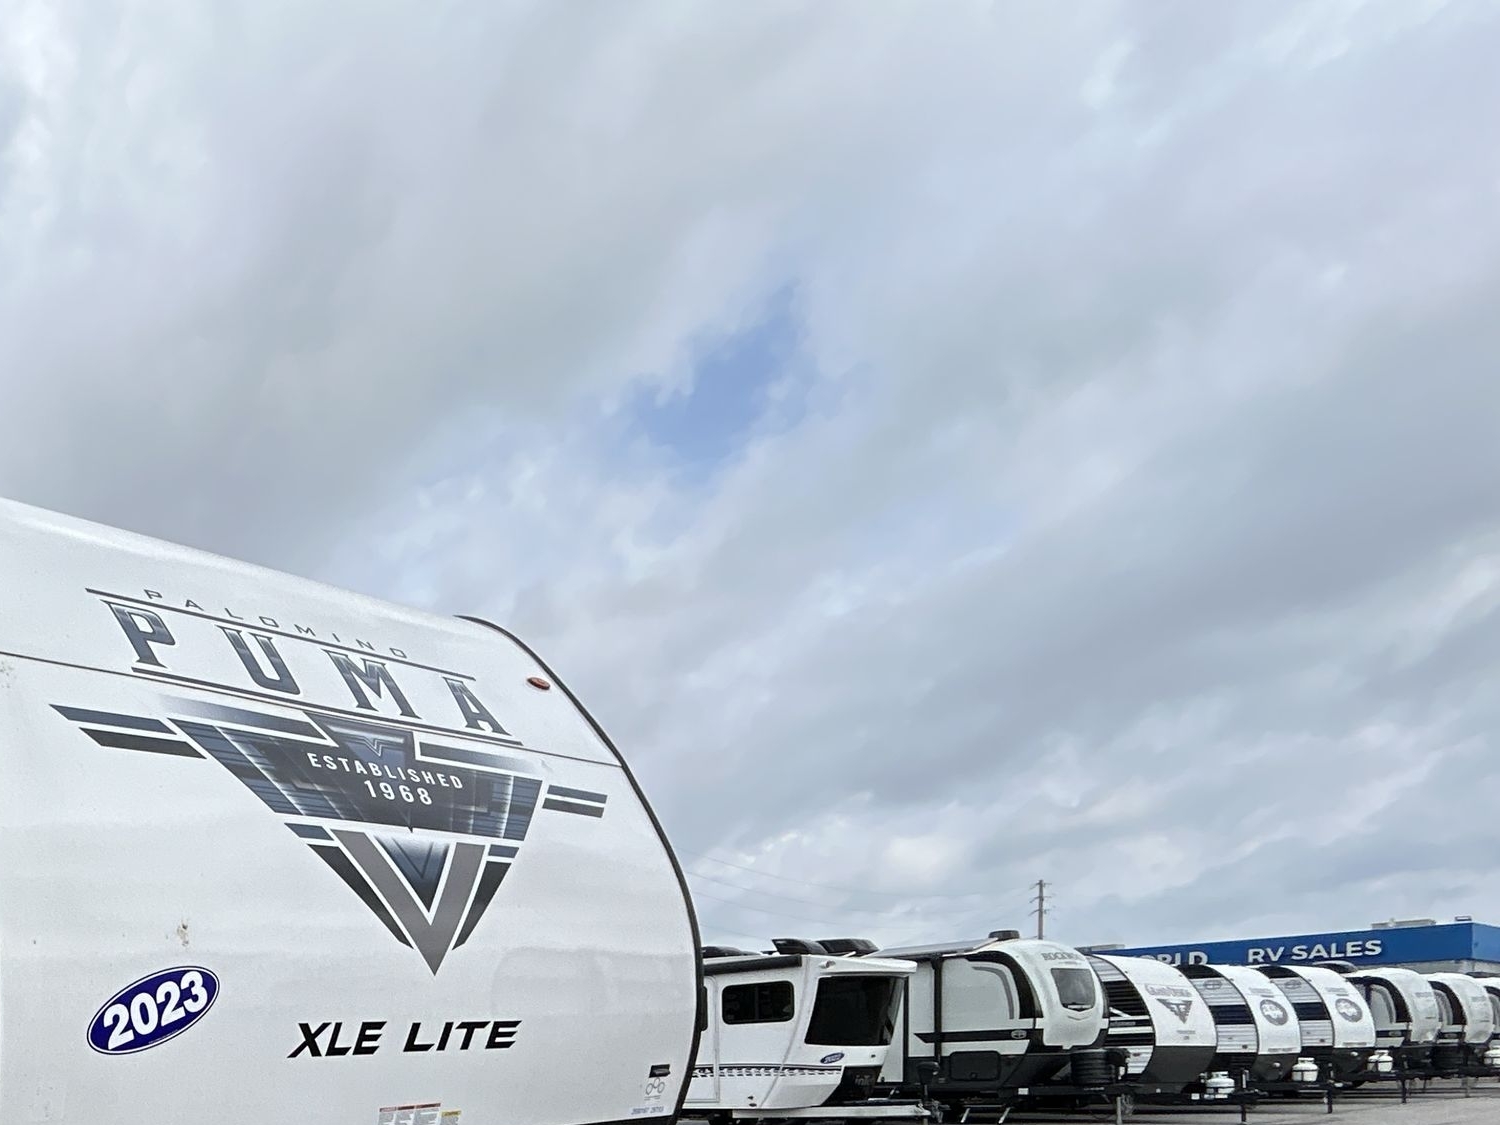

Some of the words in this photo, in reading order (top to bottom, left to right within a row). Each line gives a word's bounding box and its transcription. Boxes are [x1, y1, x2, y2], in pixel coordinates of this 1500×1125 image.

[144, 589, 408, 659] PALOMINO
[100, 599, 513, 737] PUMA
[306, 752, 464, 790] ESTABLISHED
[363, 780, 433, 806] 1968
[1247, 946, 1285, 963] RV
[1291, 939, 1382, 961] SALES
[103, 970, 209, 1051] 2023
[286, 1020, 388, 1059] XLE
[402, 1019, 523, 1053] LITE
